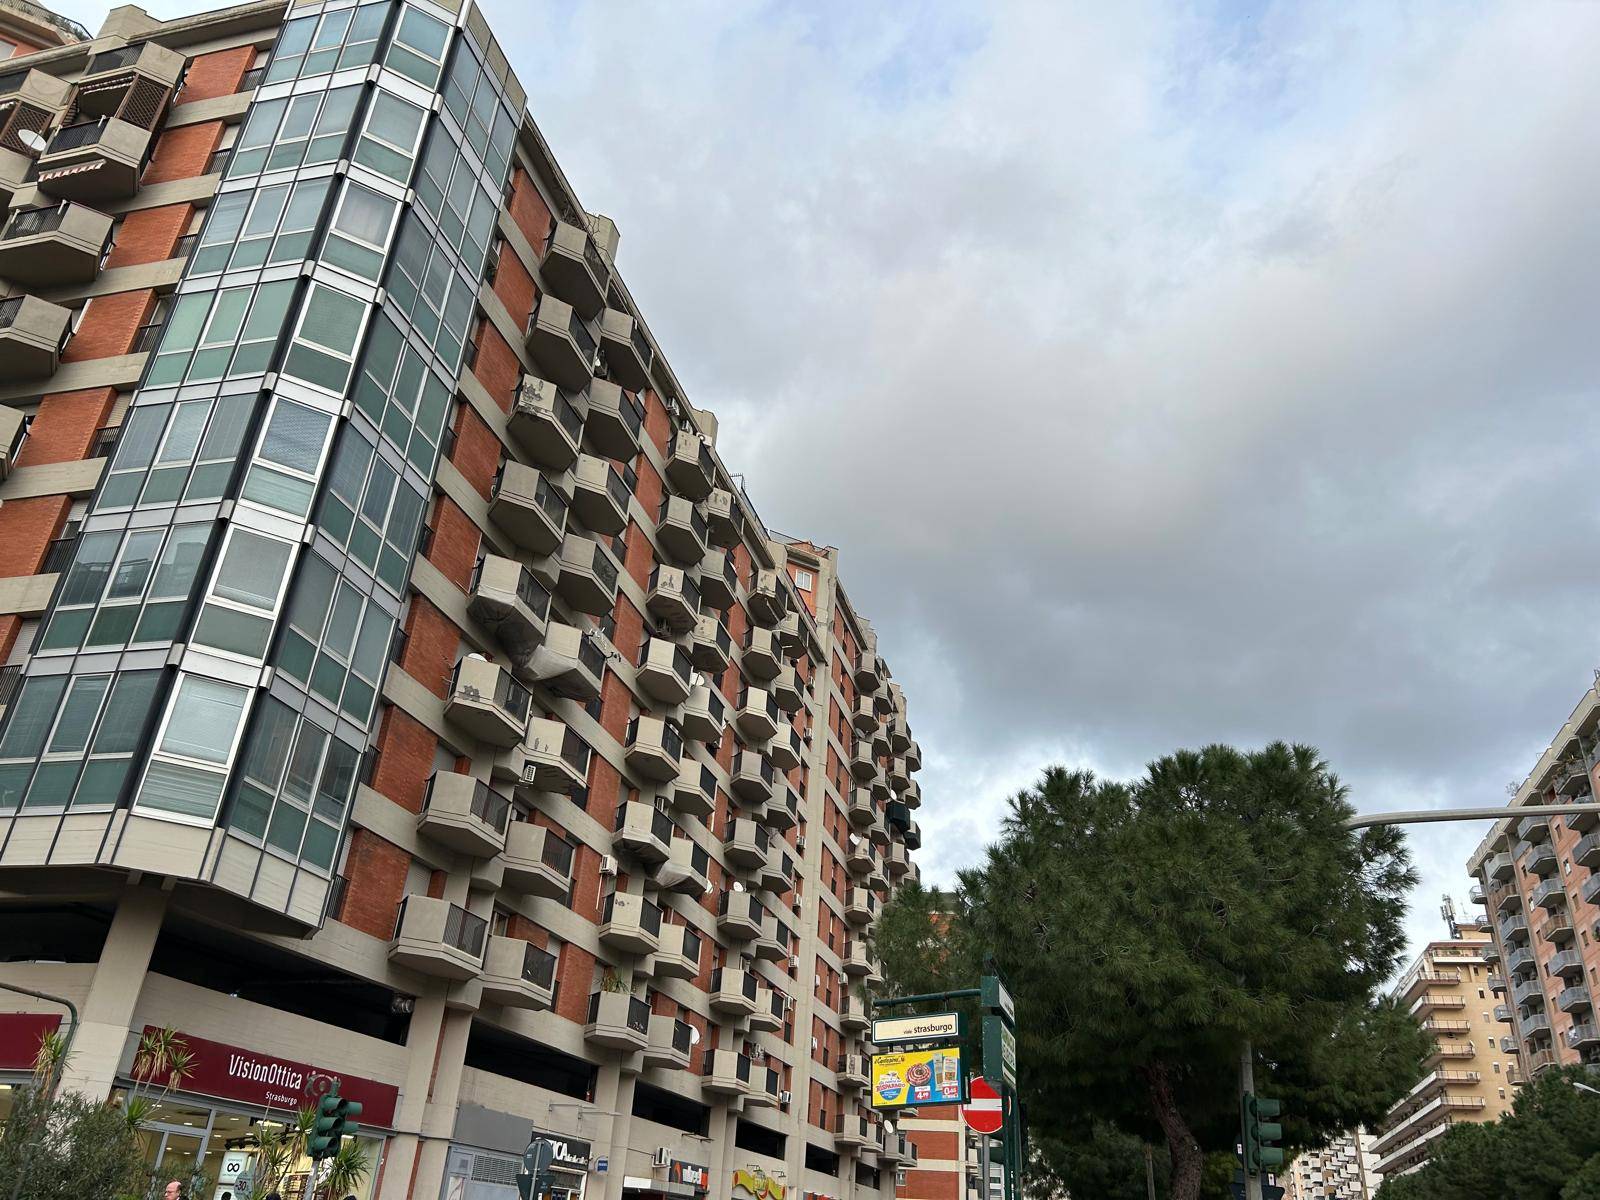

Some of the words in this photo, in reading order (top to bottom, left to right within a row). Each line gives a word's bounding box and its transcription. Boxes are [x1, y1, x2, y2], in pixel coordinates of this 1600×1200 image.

[913, 1023, 953, 1033] strasburgo
[229, 1054, 303, 1090] VisionOttica
[265, 1091, 298, 1106] Strasburgo
